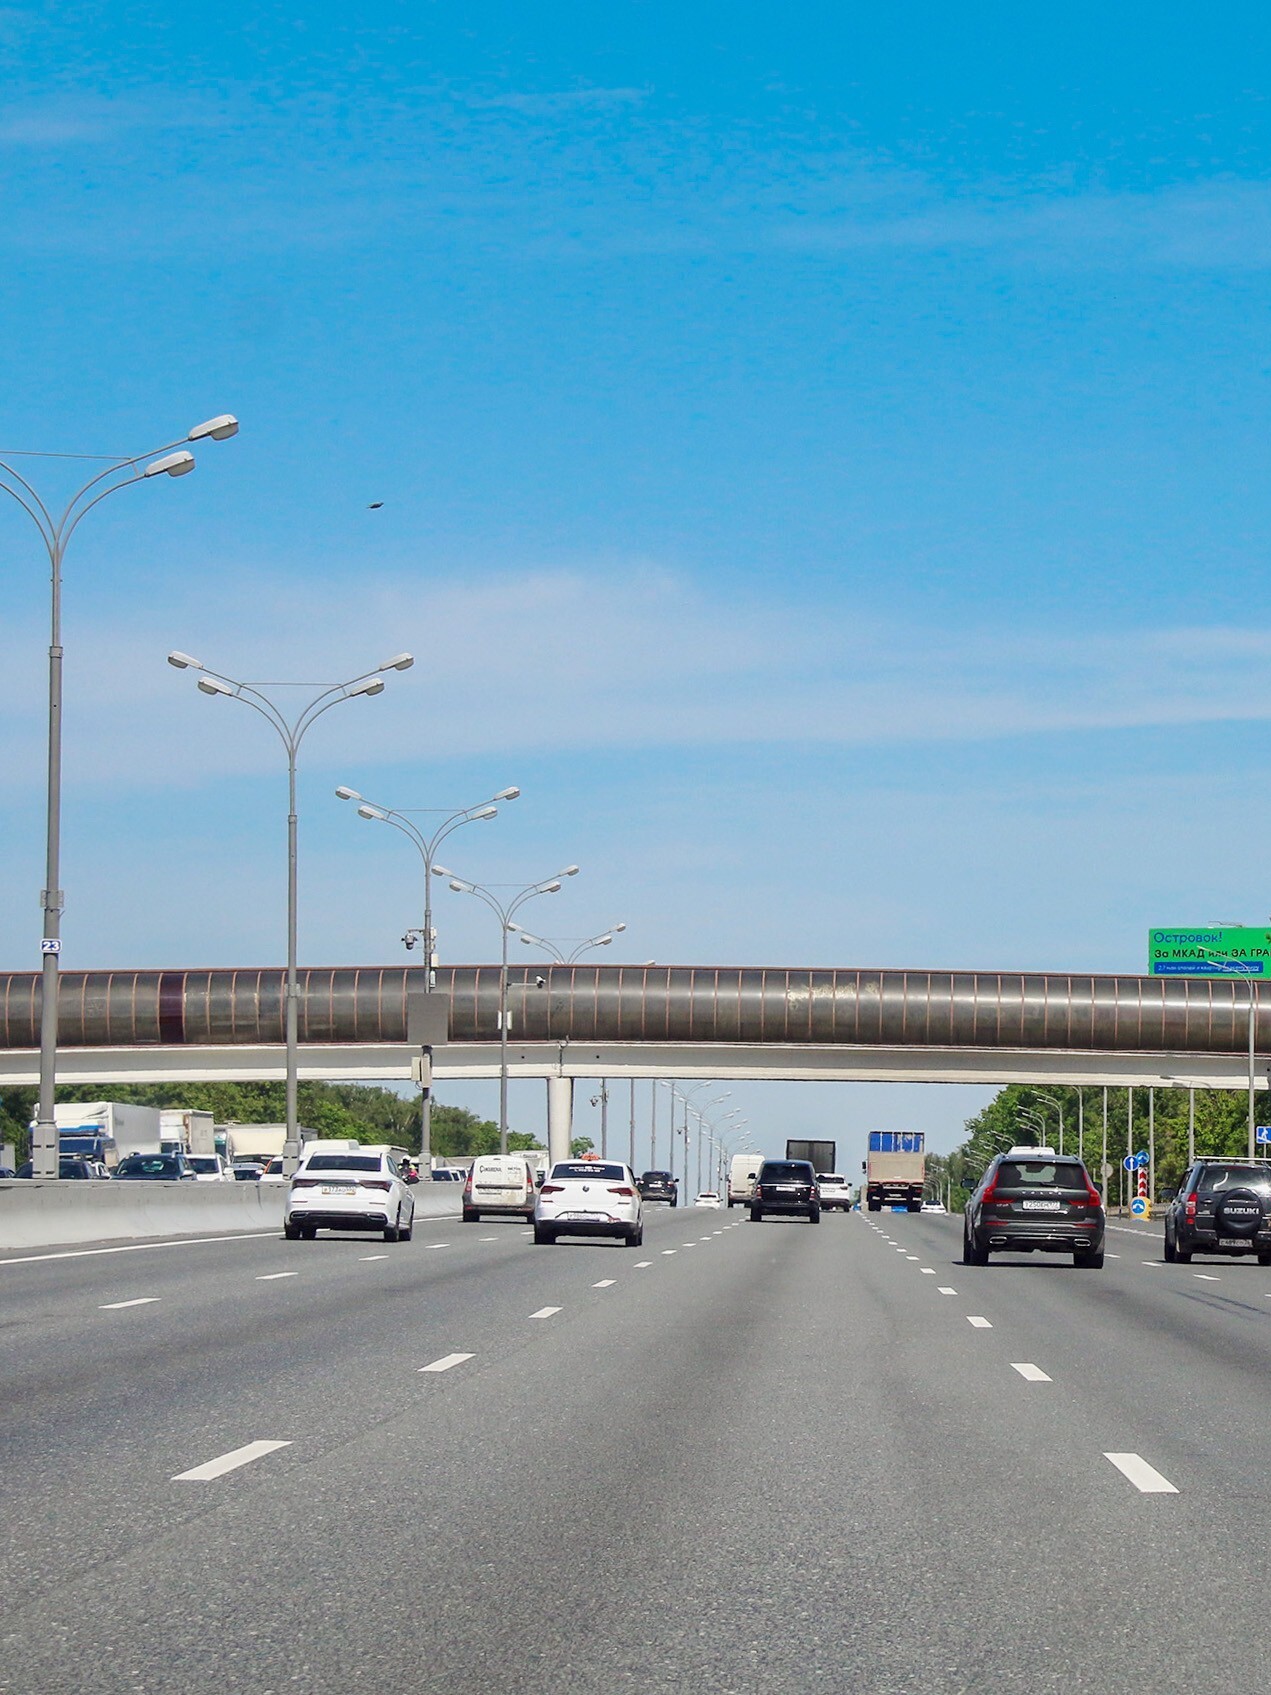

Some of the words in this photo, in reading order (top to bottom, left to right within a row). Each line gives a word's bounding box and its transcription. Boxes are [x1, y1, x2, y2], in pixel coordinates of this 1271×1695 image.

[1153, 931, 1223, 945] Островок!
[42, 941, 60, 951] 23
[1154, 949, 1169, 958] За
[1172, 948, 1205, 958] МКАД
[1223, 1206, 1260, 1215] SUZUKI
